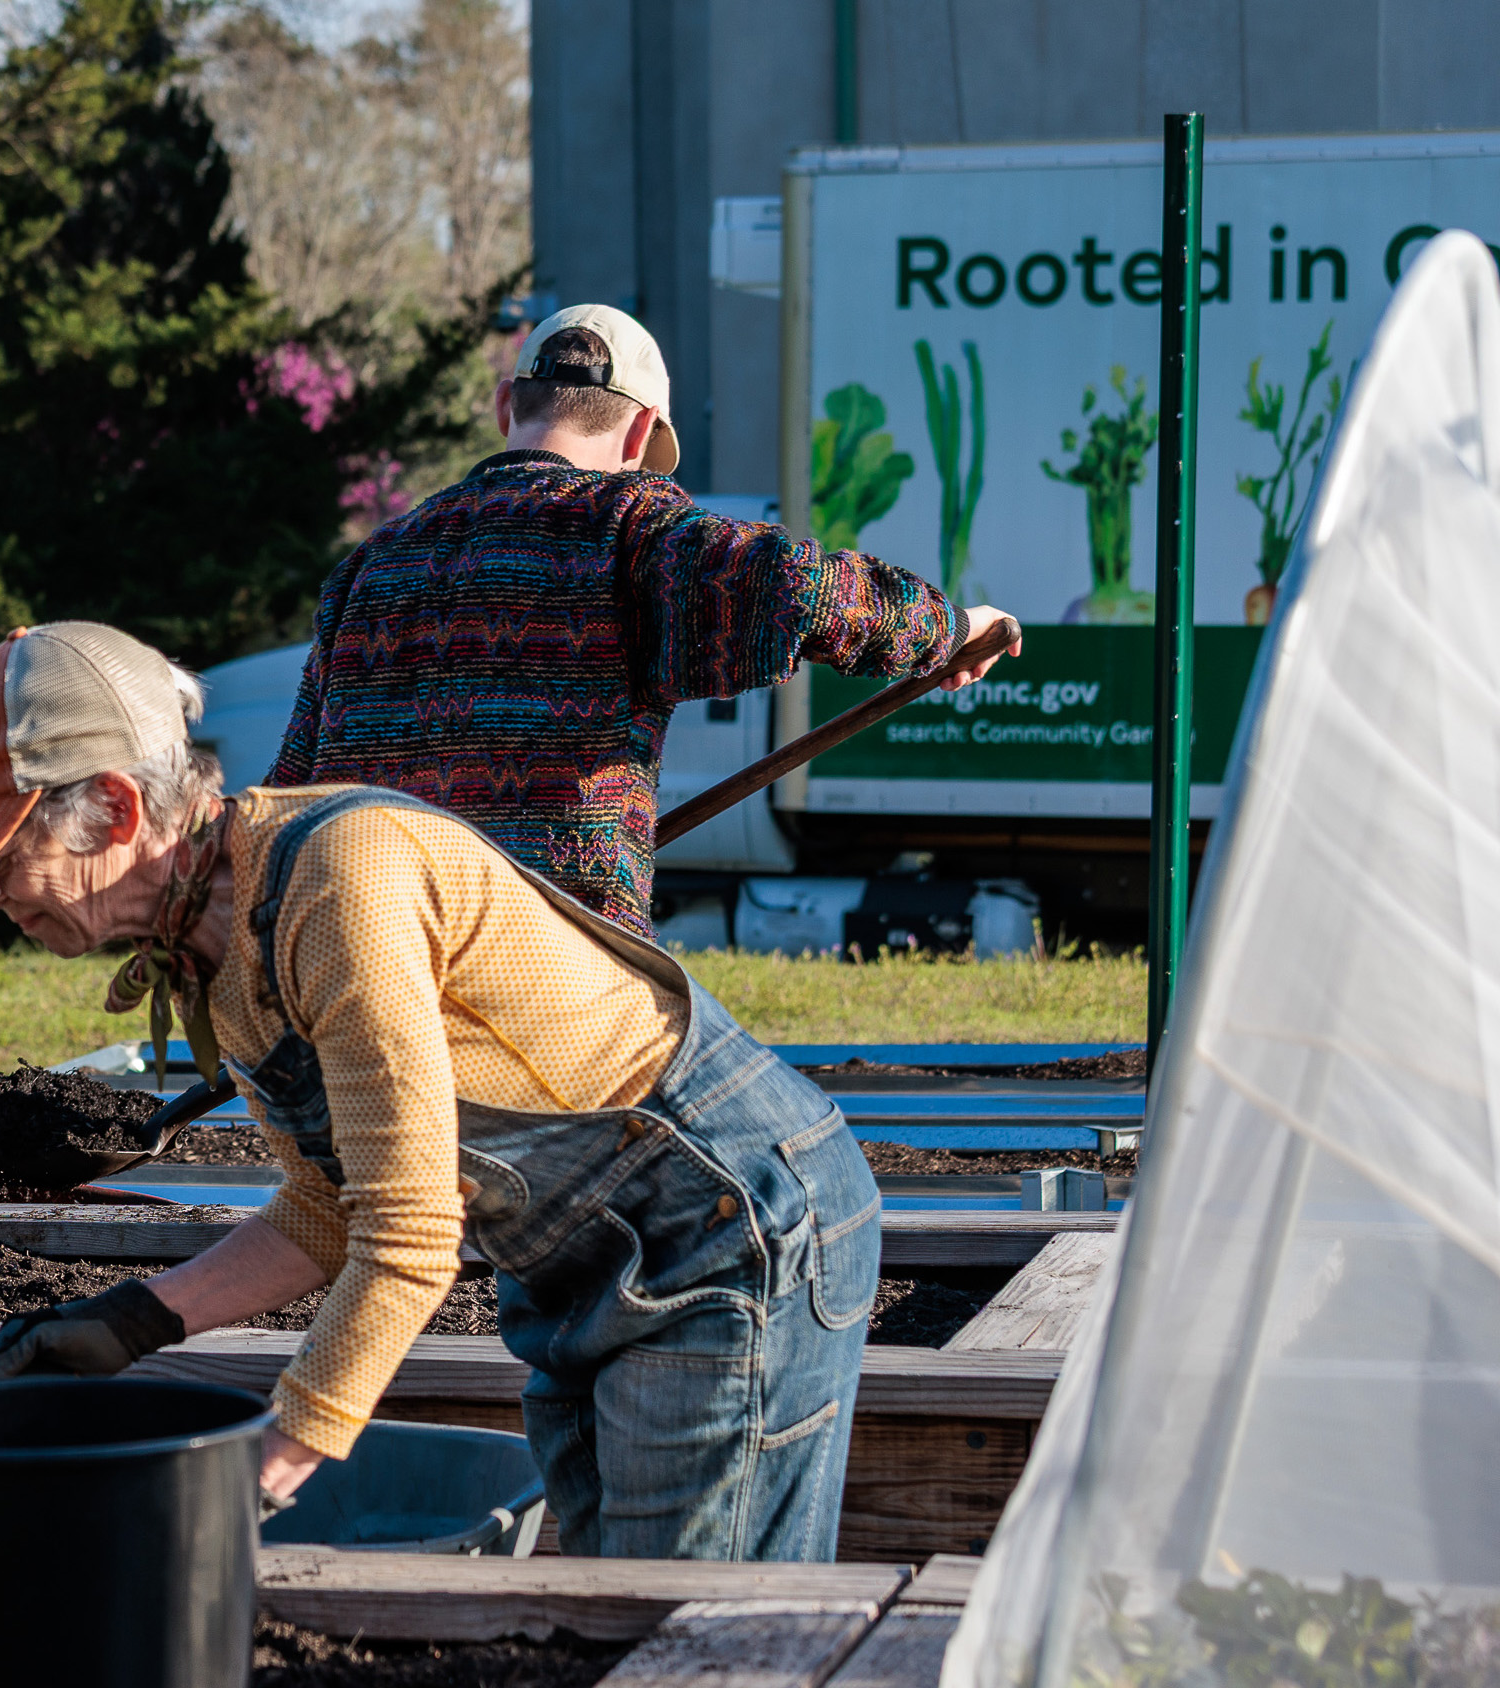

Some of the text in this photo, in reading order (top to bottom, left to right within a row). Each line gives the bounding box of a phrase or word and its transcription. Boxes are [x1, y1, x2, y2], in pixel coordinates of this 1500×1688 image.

[897, 223, 1232, 309] Rooted
[1268, 223, 1348, 302] in
[886, 720, 966, 744] search:
[970, 719, 1106, 748] Community
